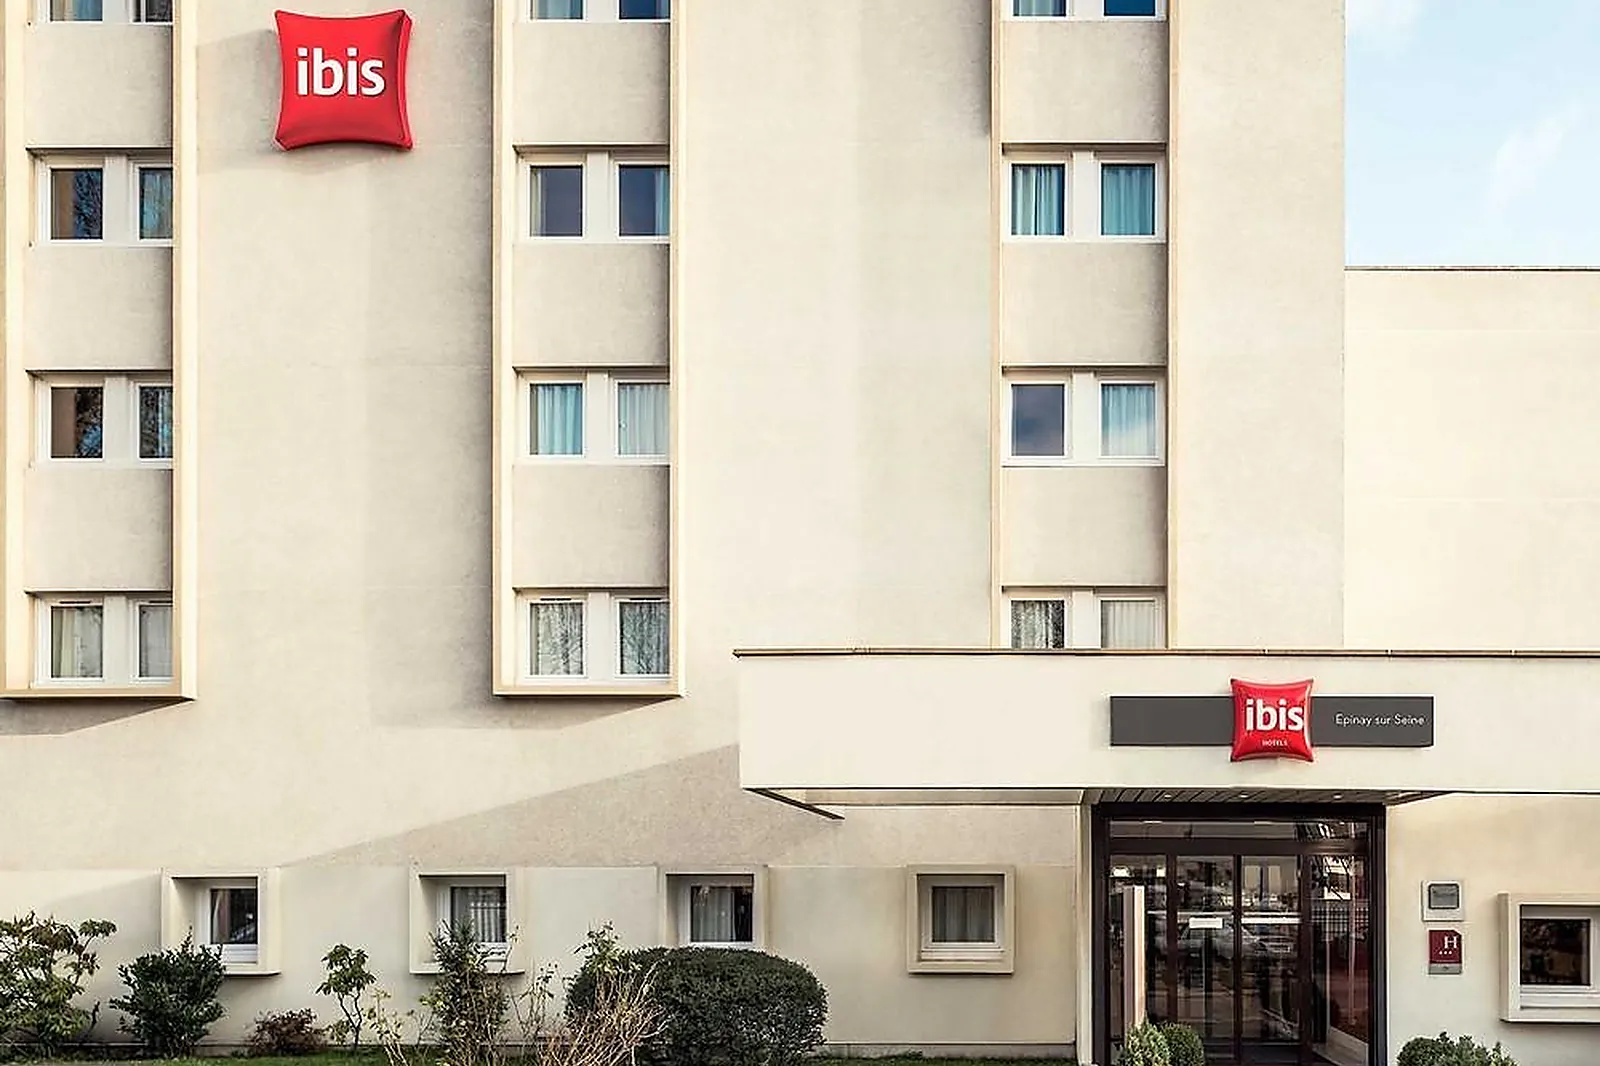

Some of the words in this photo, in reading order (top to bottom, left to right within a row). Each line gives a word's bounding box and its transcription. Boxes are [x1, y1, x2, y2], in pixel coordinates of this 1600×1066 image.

[297, 47, 386, 97] ibis
[1246, 698, 1304, 731] ibis
[1335, 713, 1372, 728] Epinay
[1374, 716, 1391, 726] sur
[1394, 713, 1426, 726] Seine
[1262, 739, 1288, 747] HOTELS
[1444, 935, 1457, 949] H
